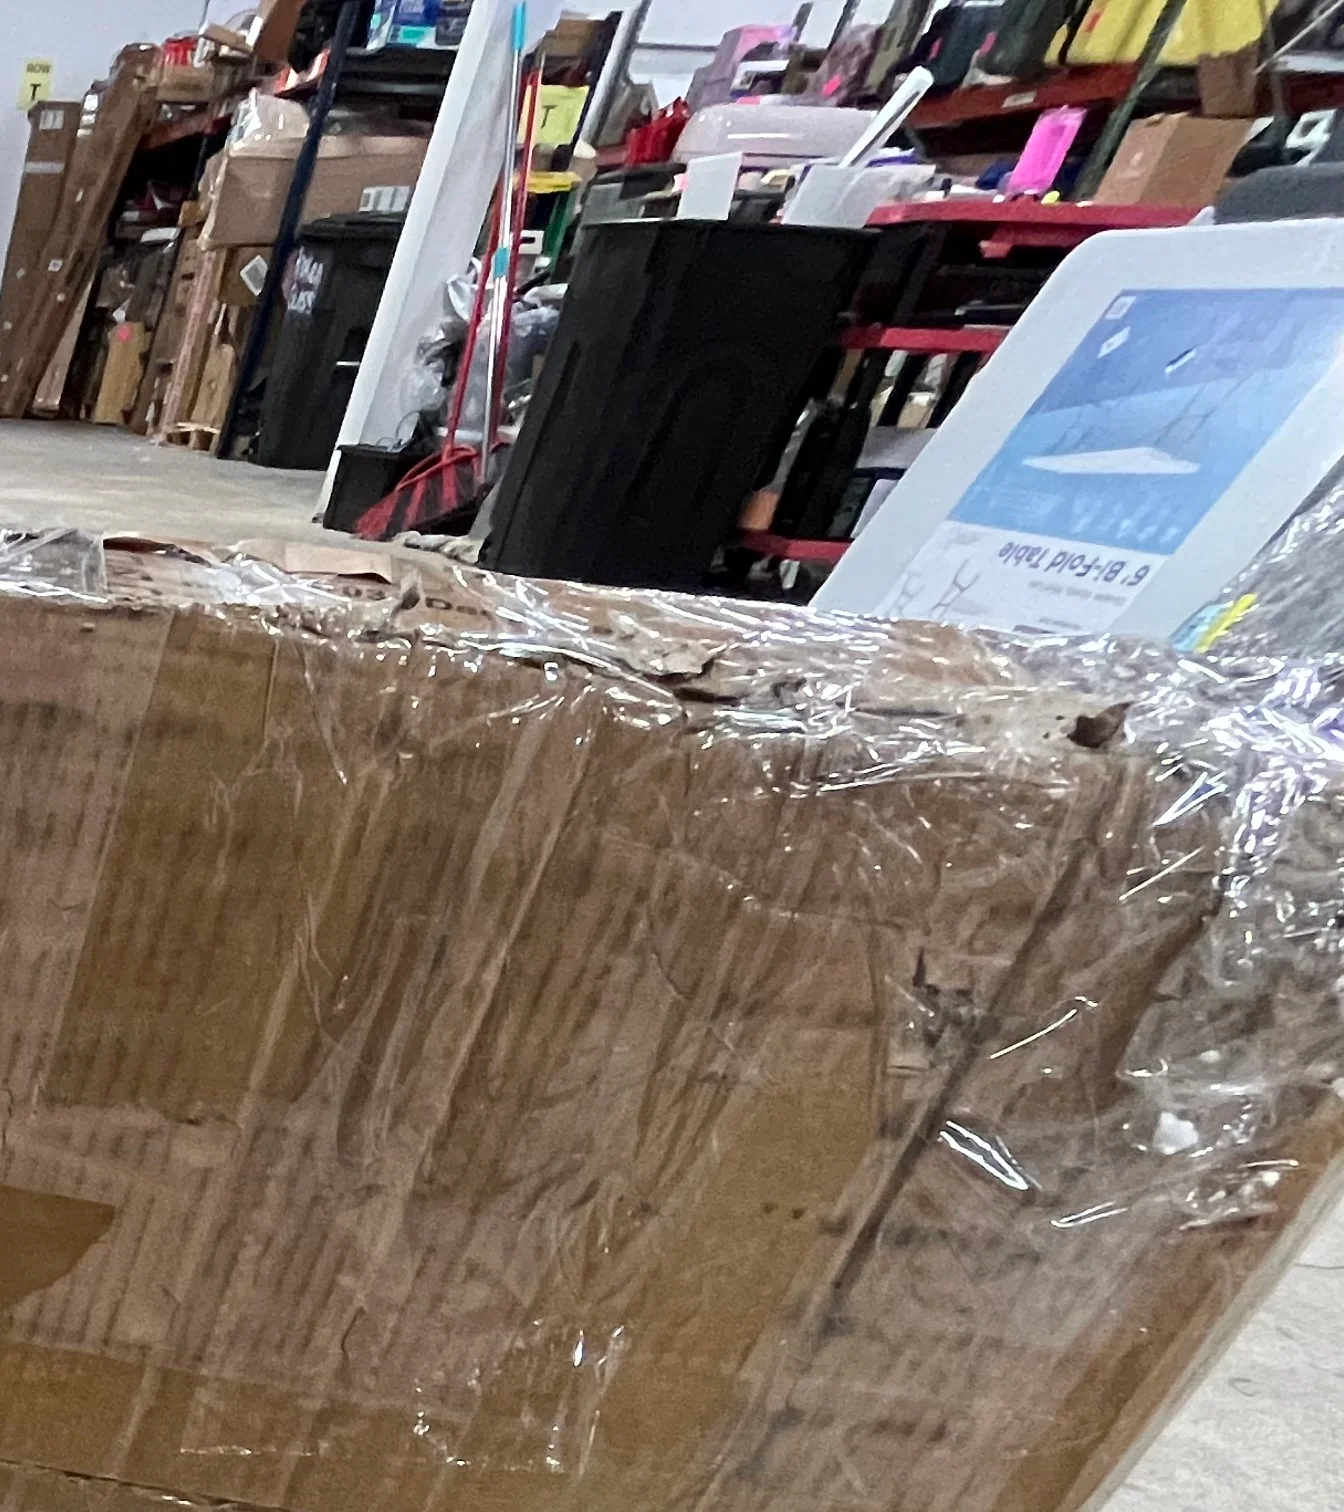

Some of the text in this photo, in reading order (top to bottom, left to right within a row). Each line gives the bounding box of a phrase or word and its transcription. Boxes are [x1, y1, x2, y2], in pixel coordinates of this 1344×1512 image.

[30, 83, 41, 101] T
[998, 541, 1050, 569] Table
[1044, 550, 1126, 582] Bi-Fold
